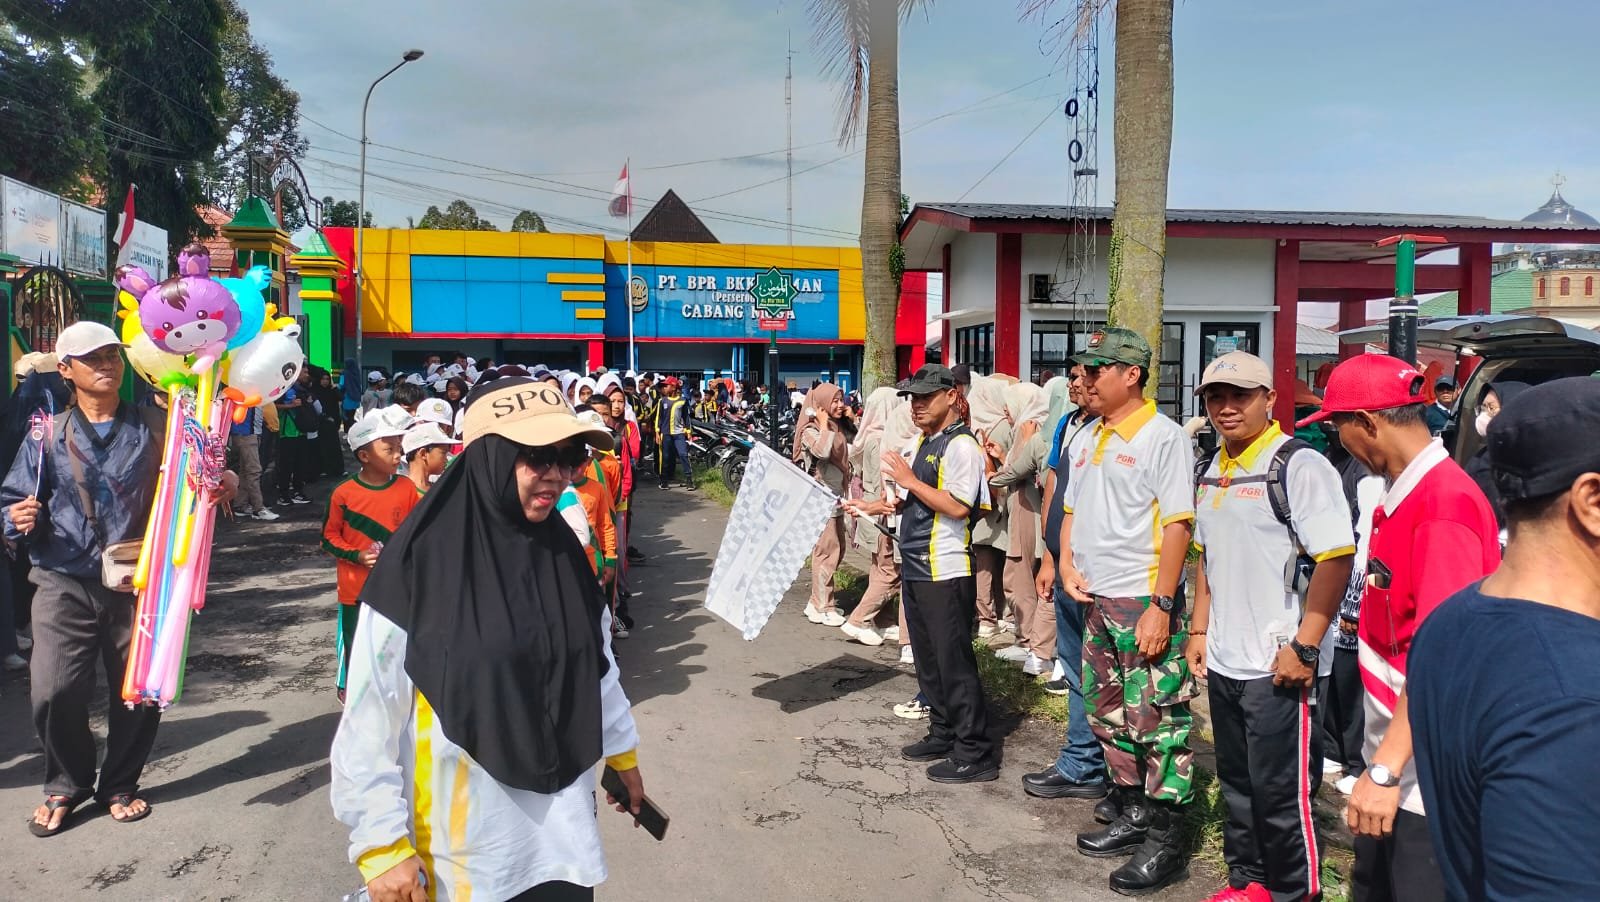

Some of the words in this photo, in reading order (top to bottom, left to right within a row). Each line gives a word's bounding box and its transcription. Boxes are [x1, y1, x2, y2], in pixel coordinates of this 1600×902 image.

[658, 275, 676, 290] PT
[687, 275, 717, 290] BPR
[726, 276, 756, 291] BKK
[681, 304, 744, 319] CABANG
[492, 388, 568, 418] SPO
[1116, 453, 1137, 465] PGRI
[1241, 487, 1265, 497] PGRI
